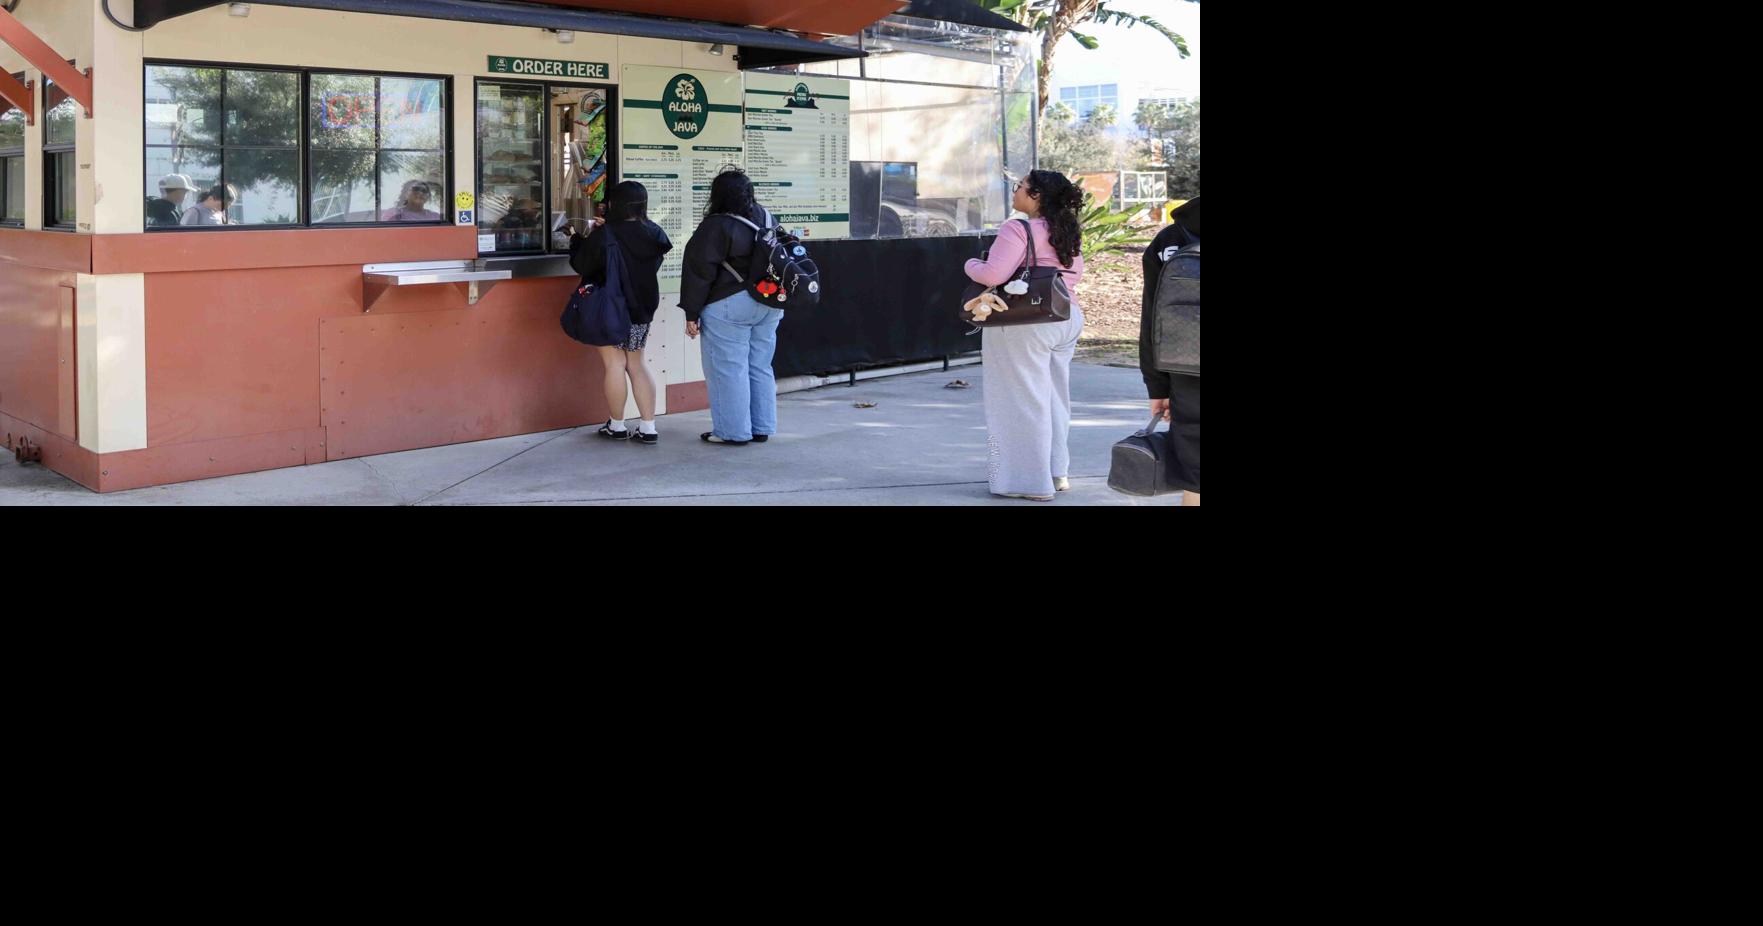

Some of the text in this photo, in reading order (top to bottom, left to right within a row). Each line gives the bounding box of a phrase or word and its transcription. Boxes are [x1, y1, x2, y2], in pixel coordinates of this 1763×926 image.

[512, 59, 604, 78] ORDER HERE
[668, 102, 702, 113] ALOHA
[673, 122, 698, 133] JAVA
[779, 214, 819, 223] alohajava.biz
